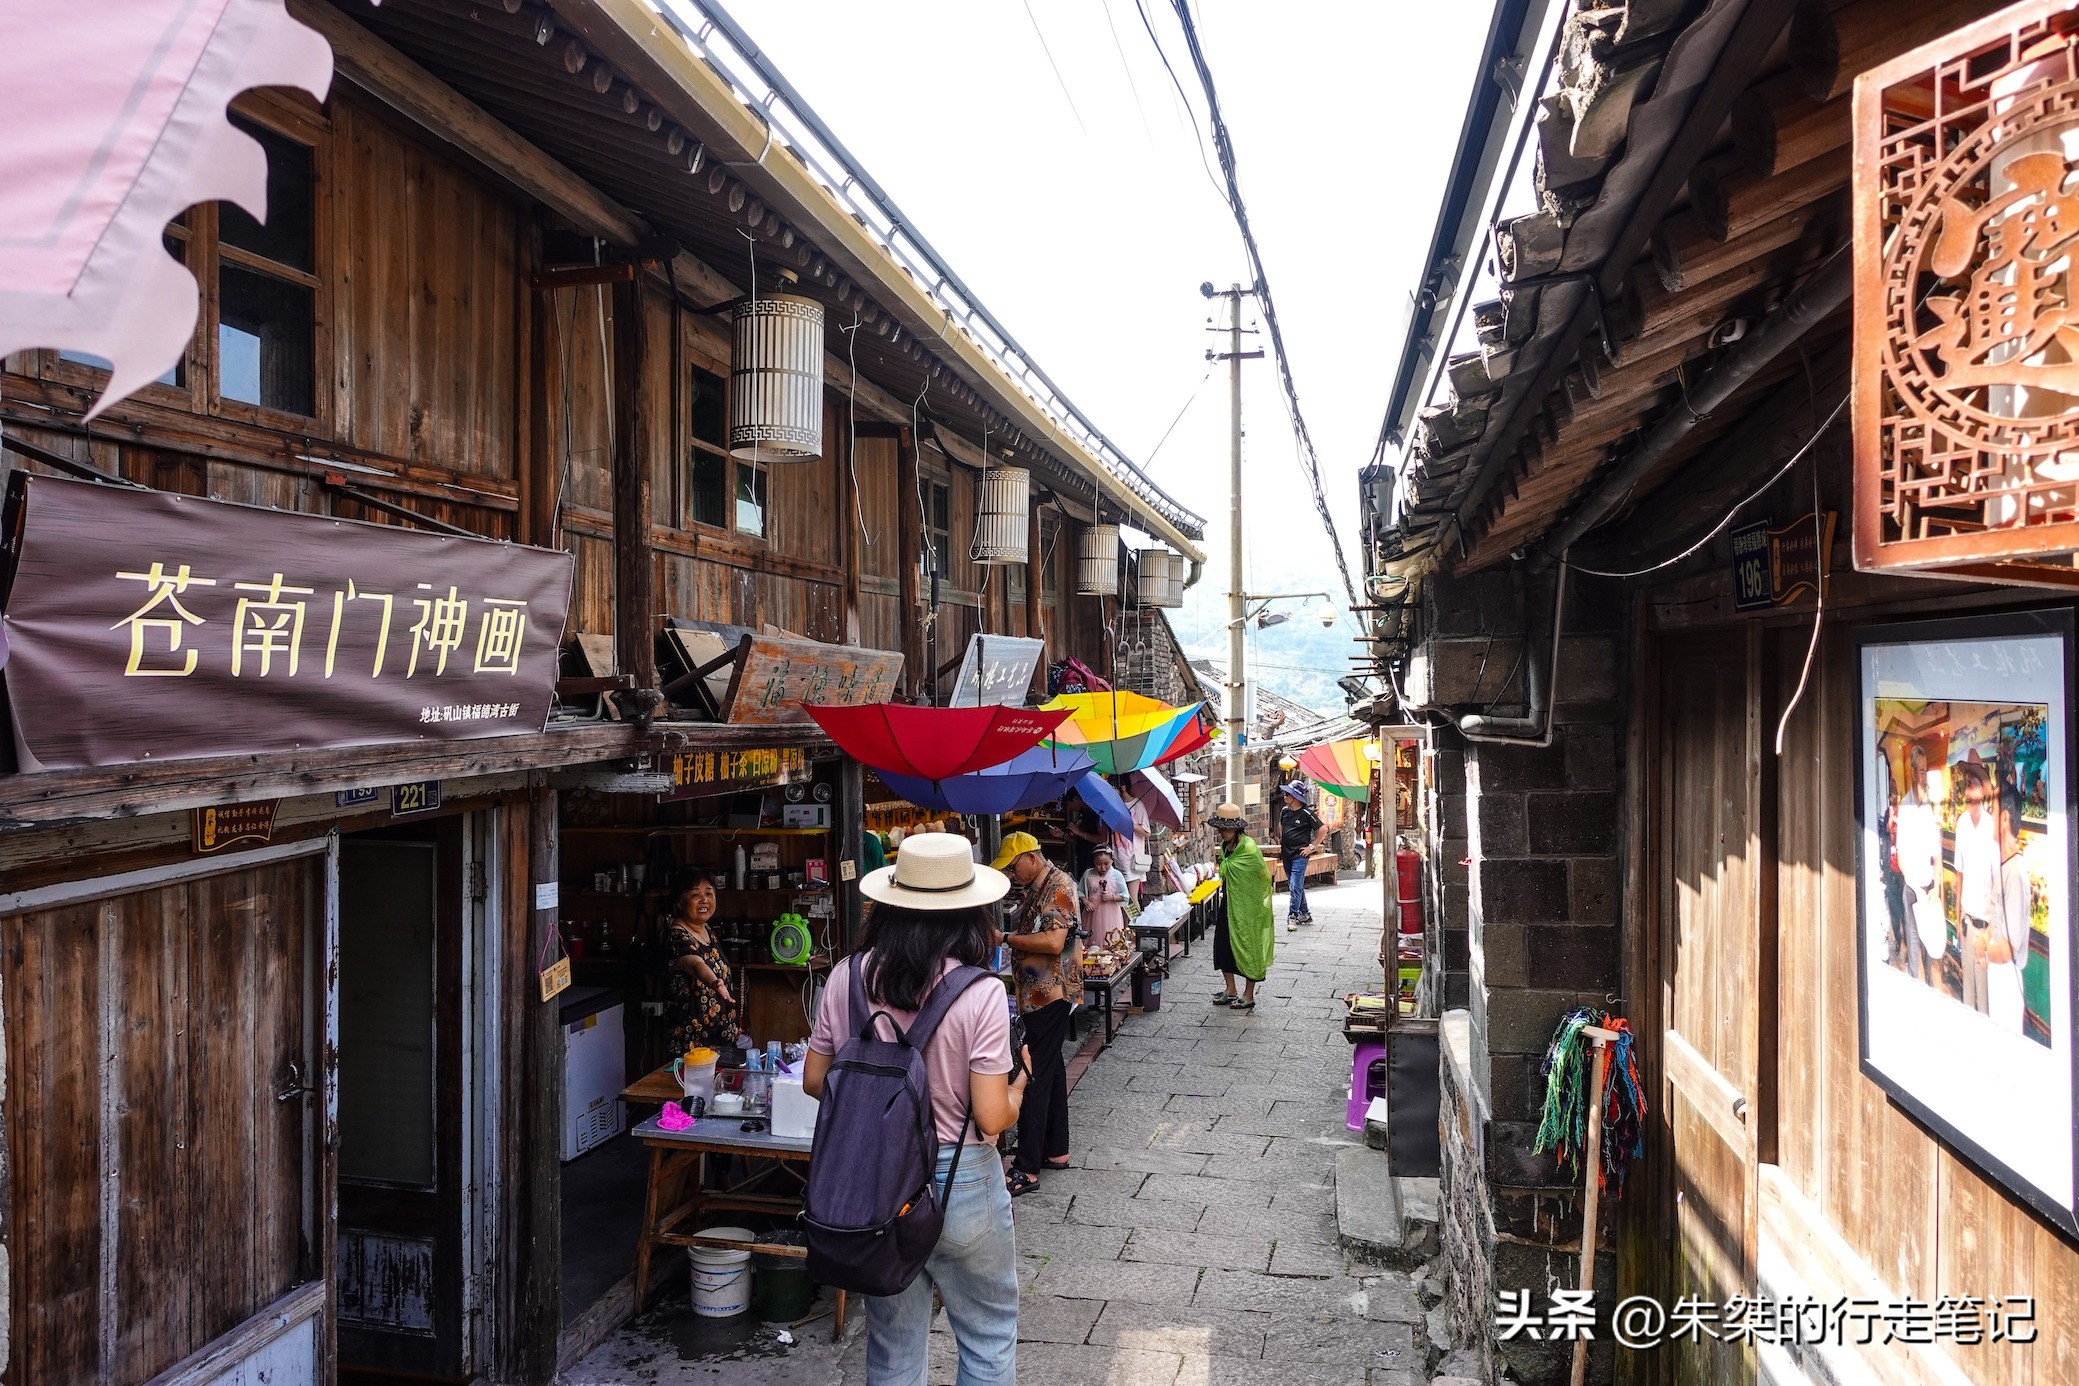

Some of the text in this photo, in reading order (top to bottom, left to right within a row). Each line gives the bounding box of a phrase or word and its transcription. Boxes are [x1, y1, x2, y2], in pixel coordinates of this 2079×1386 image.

[1738, 558, 1762, 599] 196
[110, 562, 528, 679] 苍南门神画
[673, 752, 715, 786] 柚子皮糖
[720, 750, 749, 780] 柚子茶
[400, 783, 426, 809] 221
